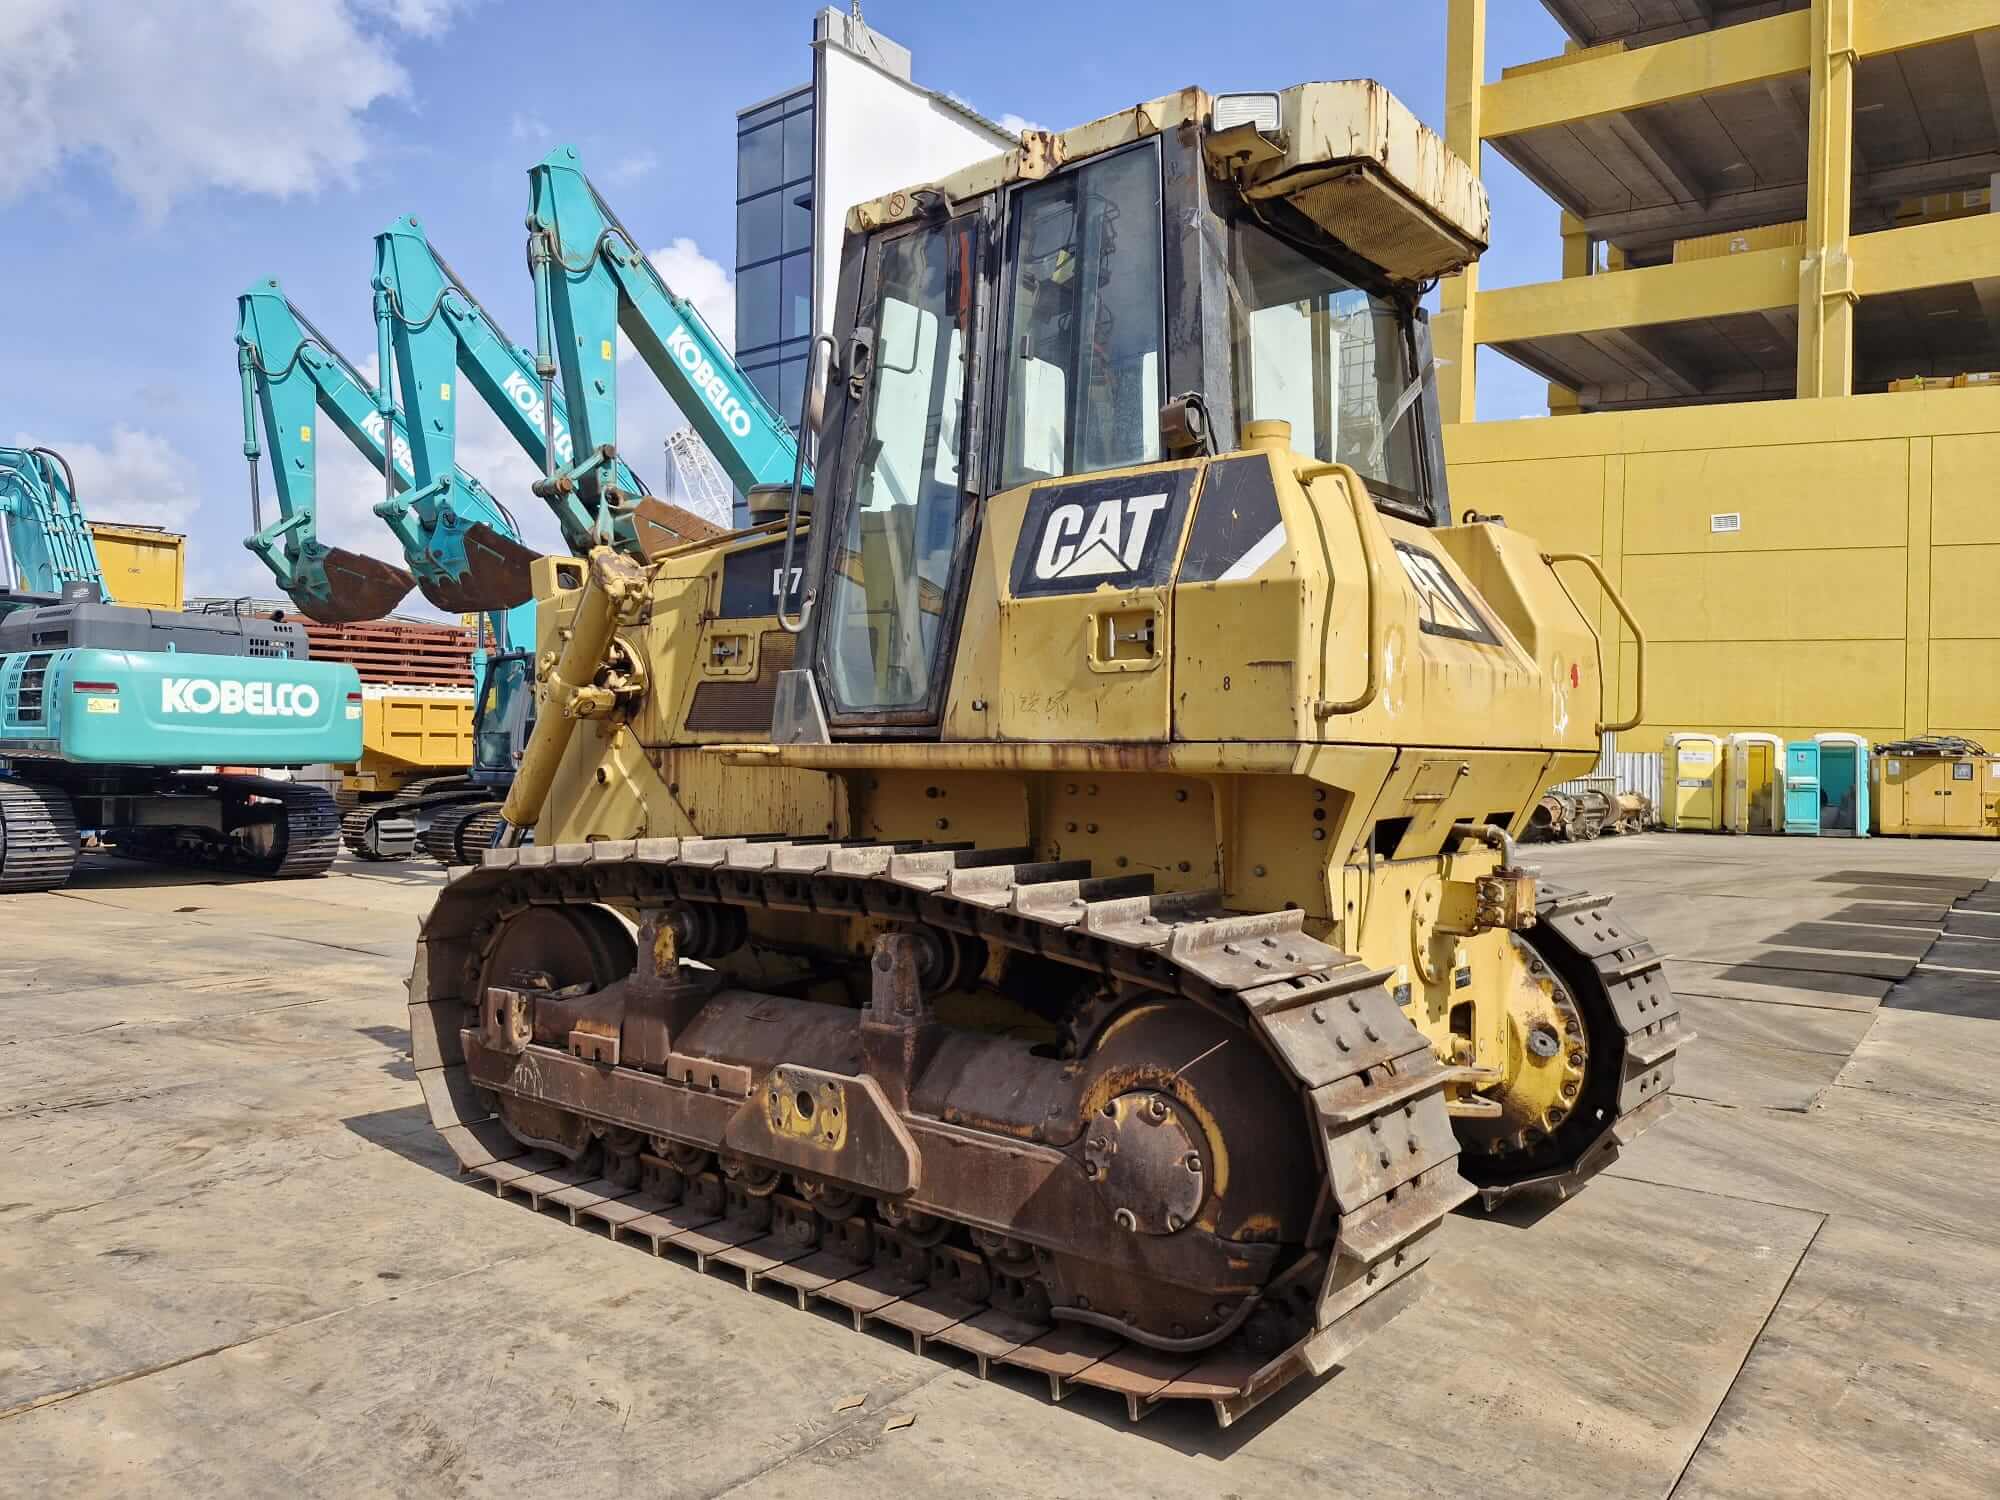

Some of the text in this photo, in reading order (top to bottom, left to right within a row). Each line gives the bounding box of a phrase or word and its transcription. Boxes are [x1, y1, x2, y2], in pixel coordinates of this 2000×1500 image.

[666, 324, 751, 437] KOBELCO
[1035, 493, 1169, 580] CAT
[161, 677, 320, 718] KOBELCO
[1223, 675, 1231, 691] 8
